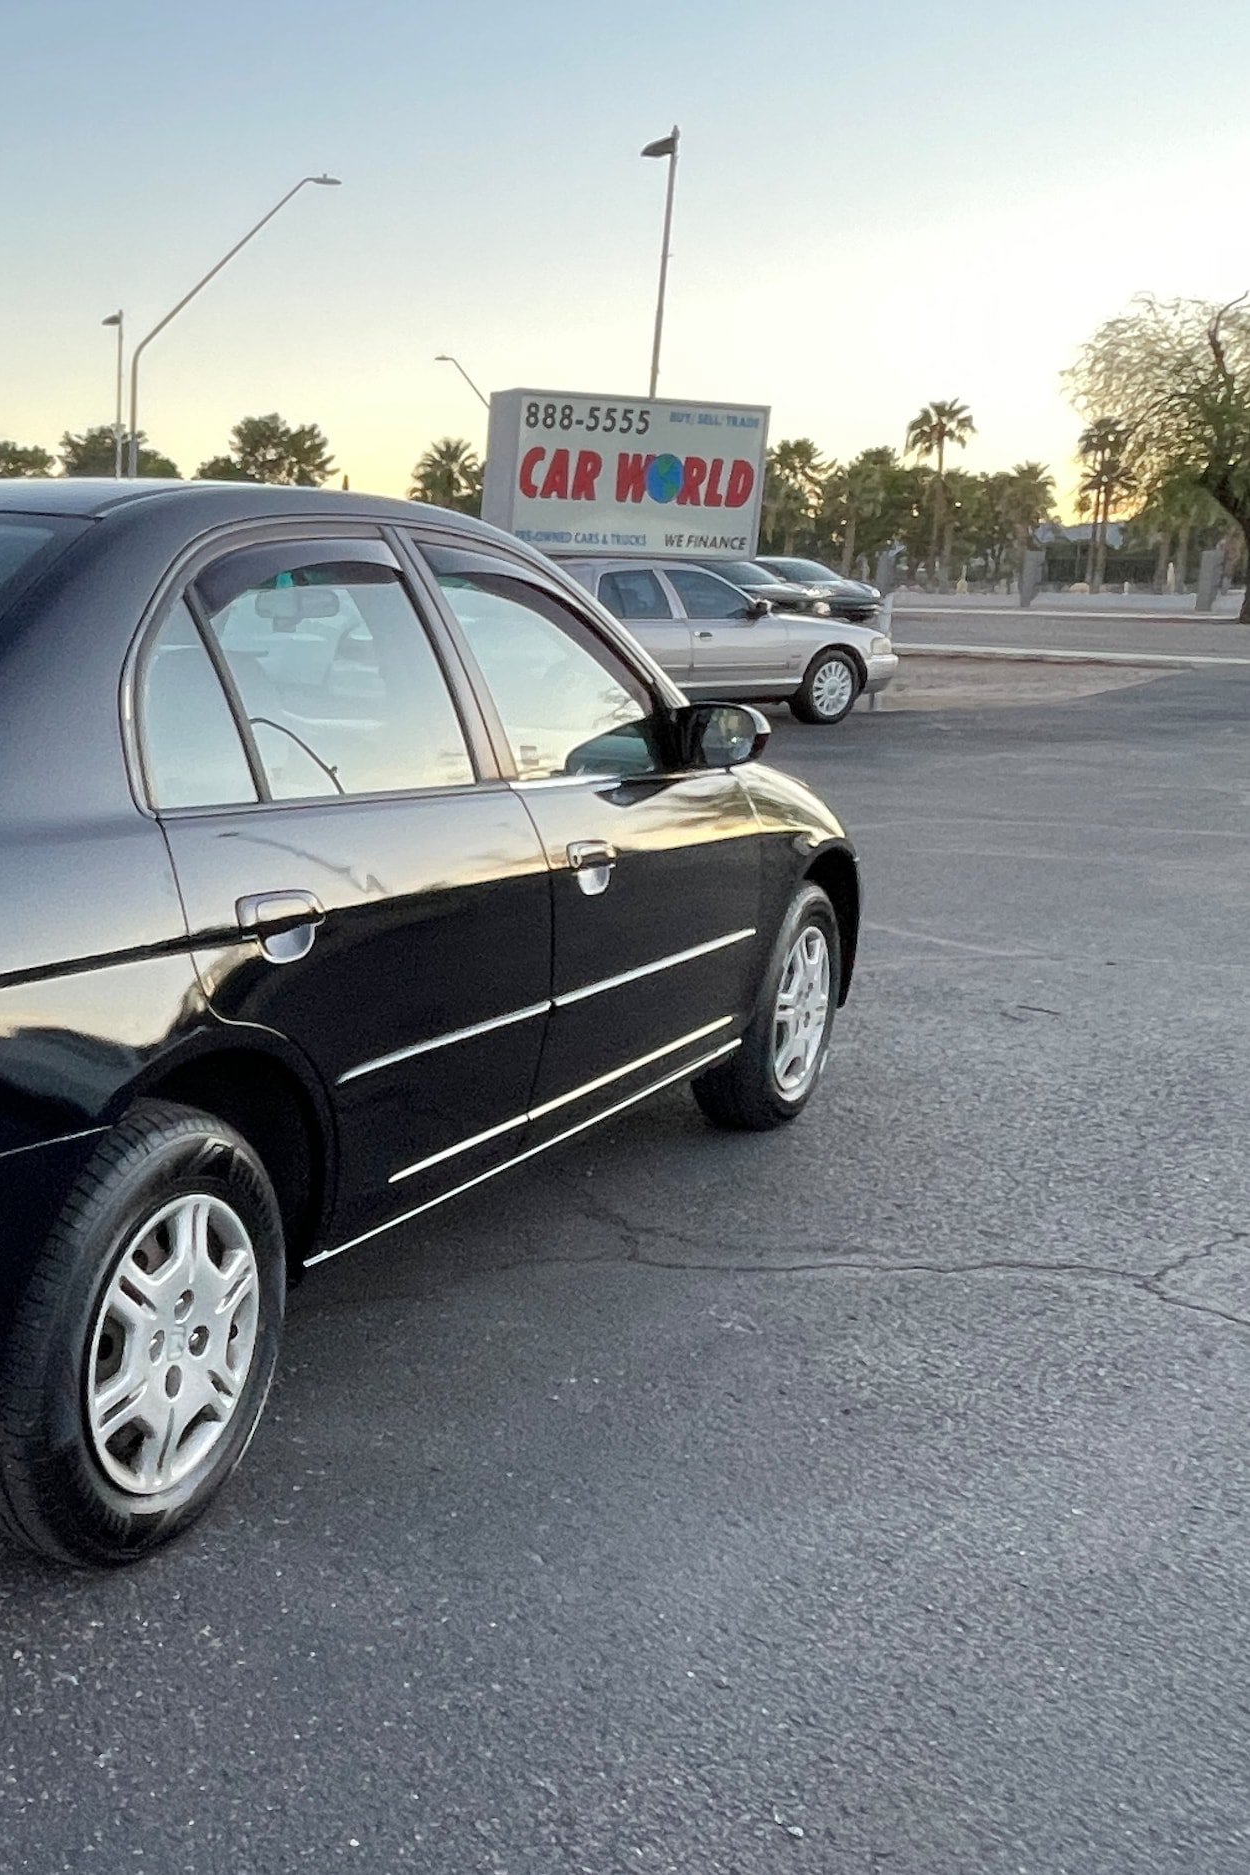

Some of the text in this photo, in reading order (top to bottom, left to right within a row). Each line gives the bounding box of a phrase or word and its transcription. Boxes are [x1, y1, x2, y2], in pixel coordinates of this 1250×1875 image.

[525, 402, 651, 435] 888-5555
[519, 446, 755, 508] CAR WORLD
[574, 532, 600, 545] CARS
[664, 534, 748, 550] WE FINANCE
